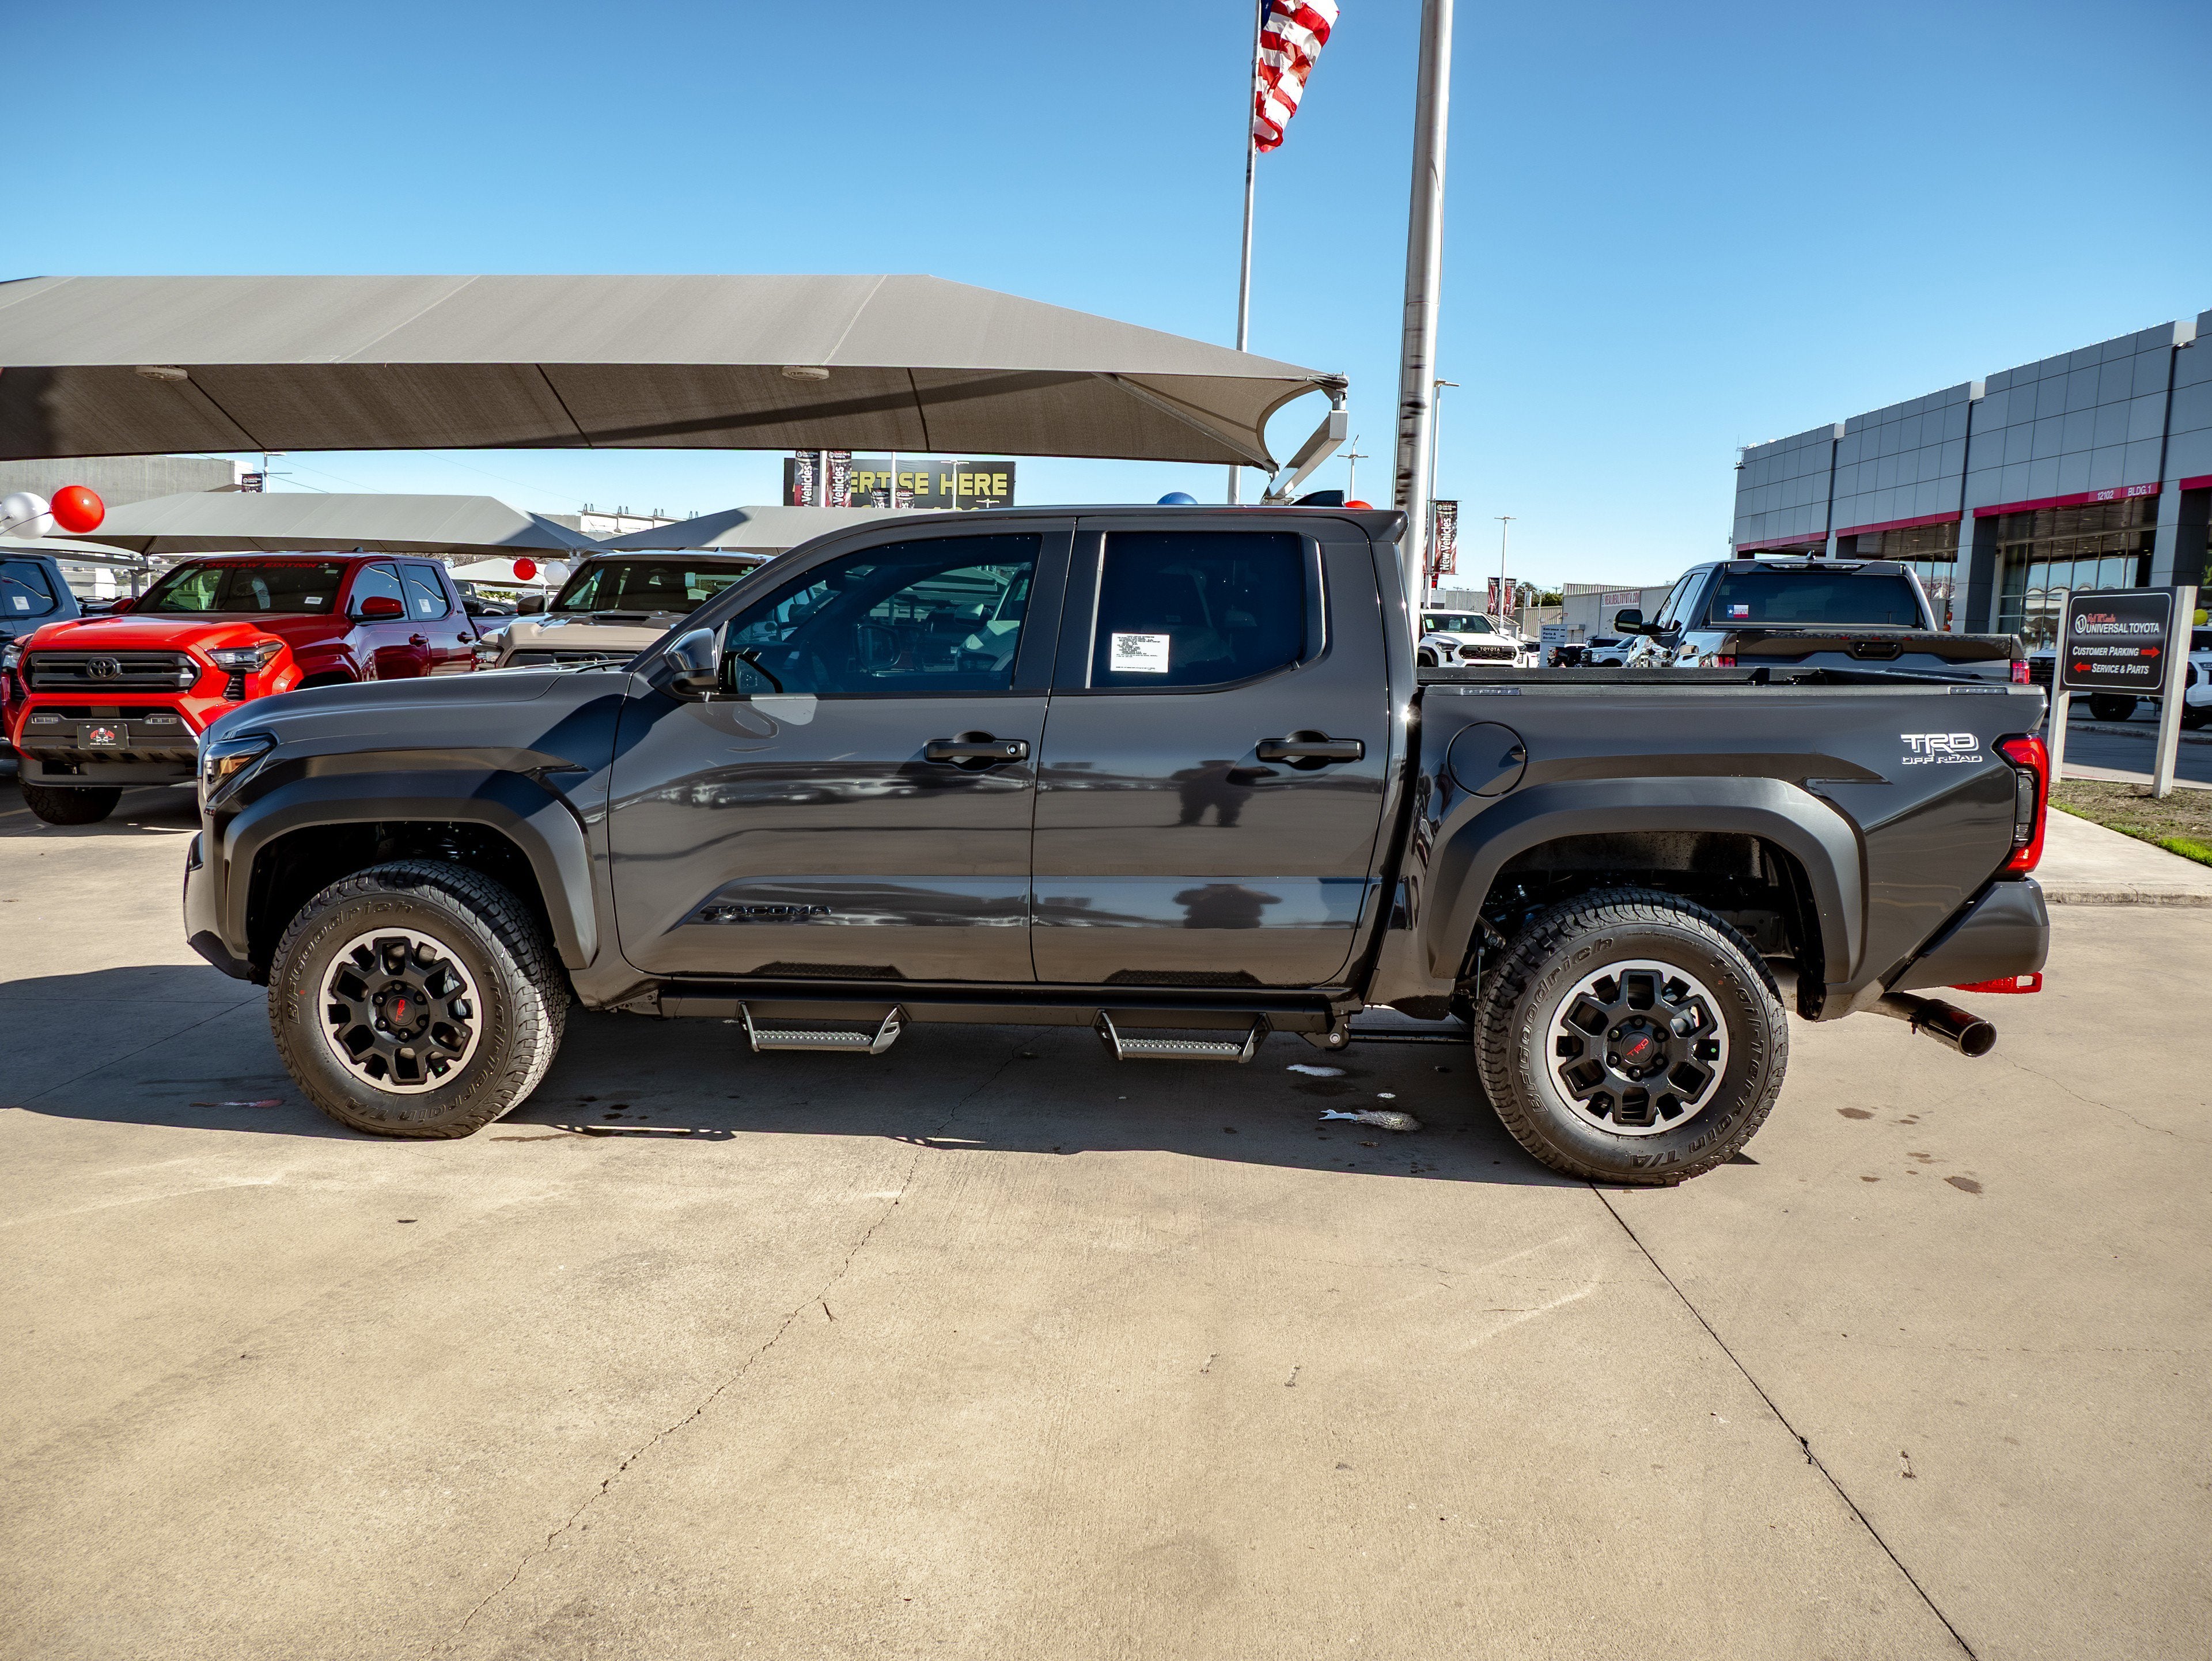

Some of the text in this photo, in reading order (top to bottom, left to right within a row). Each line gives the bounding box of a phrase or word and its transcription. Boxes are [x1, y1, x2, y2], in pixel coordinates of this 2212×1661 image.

[801, 465, 813, 502] Vehicles
[832, 466, 844, 503] Vehicles
[940, 472, 1007, 496] HERE
[2097, 490, 2114, 501] 12102
[1441, 517, 1452, 551] Vehicles
[1440, 551, 1450, 571] New
[2086, 622, 2160, 633] UNIVERSAL TOYOTA
[2073, 646, 2139, 656] CUSTOMER PARKING
[2092, 663, 2150, 675] SERVICE & PARTS
[1900, 733, 1979, 757] TRD
[1902, 755, 1983, 765] OFF ROAD
[706, 905, 831, 916] TACOMA
[287, 901, 413, 1024] BFGoodrich
[395, 1000, 406, 1022] TRD
[1518, 937, 1614, 1113] BFGoodrich
[1626, 1038, 1649, 1056] TRD
[345, 1096, 389, 1122] T/A
[1630, 1151, 1681, 1169] T/A
